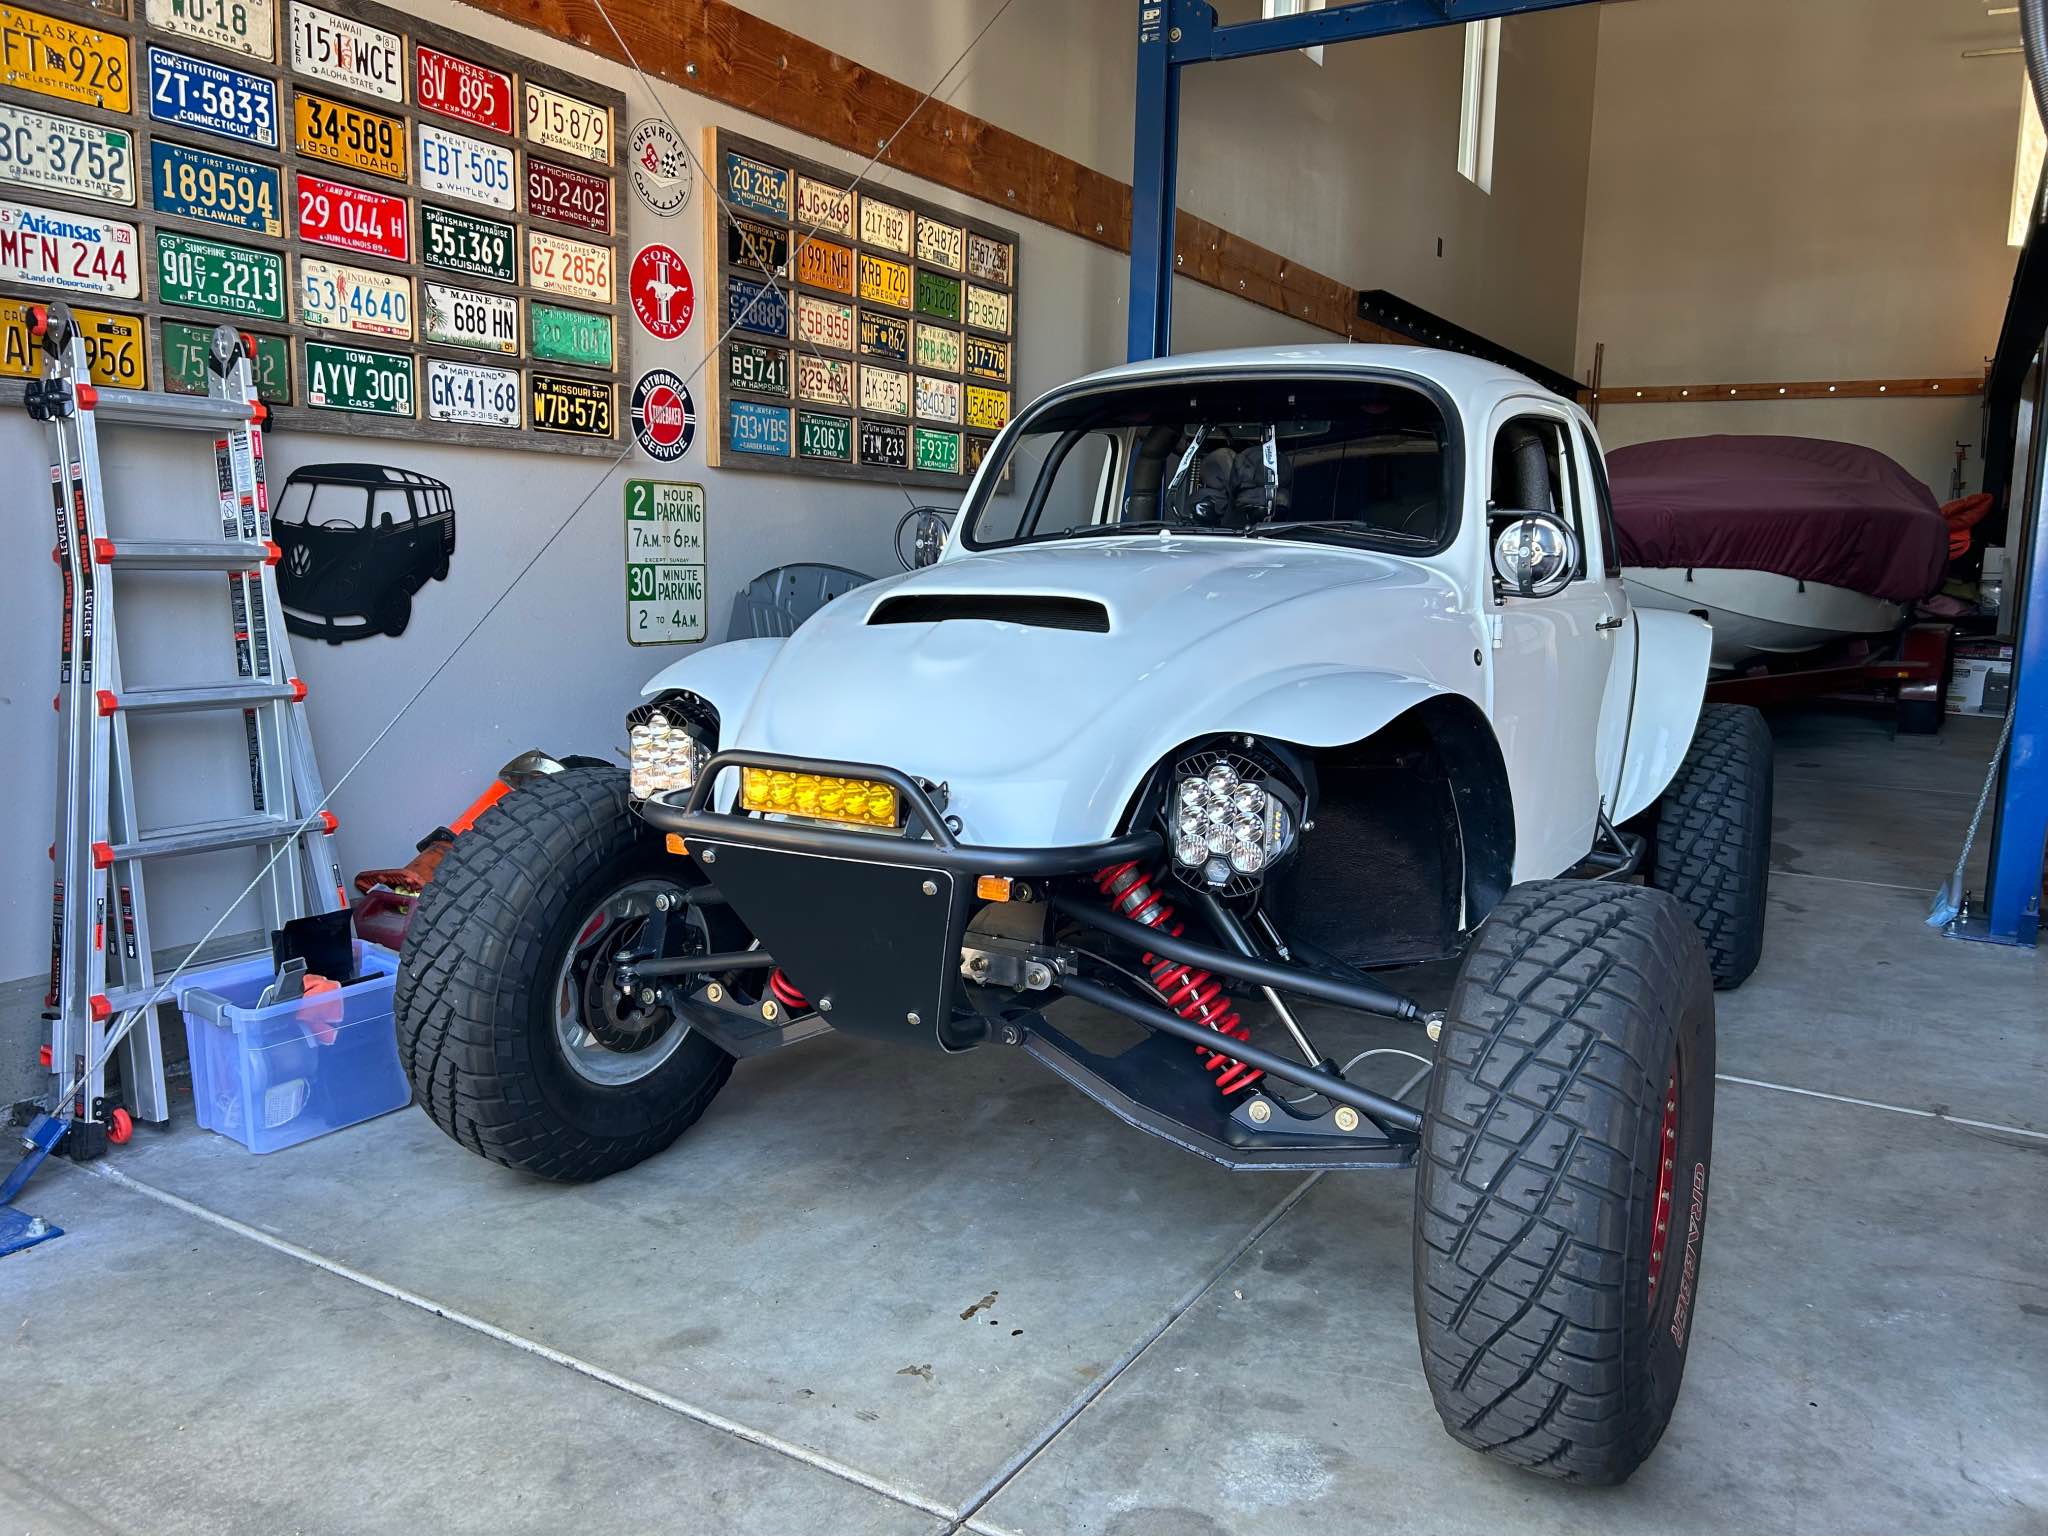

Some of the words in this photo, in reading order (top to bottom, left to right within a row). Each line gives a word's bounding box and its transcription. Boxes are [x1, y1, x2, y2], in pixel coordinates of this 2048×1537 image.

[14, 16, 93, 49] ALASKA
[183, 22, 237, 44] TRACTOR
[329, 18, 363, 37] HAWAII
[305, 23, 342, 68] 151
[354, 38, 397, 84] WCE
[384, 37, 395, 48] 81
[3, 27, 41, 72] FT
[68, 46, 122, 92] 928
[444, 61, 485, 80] KANSAS
[154, 54, 229, 83] CONSTITUTION
[237, 76, 270, 94] STATE
[321, 67, 348, 83] ALOHA
[350, 76, 374, 90] STATE
[33, 75, 57, 87] LAST
[59, 81, 98, 97] FRONTIER
[459, 76, 495, 116] 895
[179, 110, 250, 134] CONNECTICUT
[444, 104, 460, 113] EXP
[461, 108, 476, 120] NOV
[23, 115, 44, 129] C-2
[50, 122, 76, 139] ARIZ
[79, 128, 95, 140] 66
[442, 135, 492, 156] KENTUCKY
[541, 132, 594, 153] MASSACHUSETTS
[633, 126, 688, 169] CHEVROLET
[184, 153, 199, 163] THE
[203, 157, 223, 169] FIRST
[227, 162, 249, 174] STATE
[303, 139, 339, 157] 1930
[355, 153, 399, 173] IDAHO
[9, 165, 41, 178] GRAND
[44, 171, 83, 189] CANYON
[85, 178, 112, 192] STATE
[547, 167, 588, 185] MICHIGAN
[162, 159, 273, 218] 189594
[325, 185, 343, 196] LAND
[344, 189, 352, 198] OF
[446, 183, 490, 198] WHITLEY
[741, 191, 772, 207] MONTANA
[776, 202, 785, 210] 67
[798, 189, 820, 214] AJG
[190, 205, 247, 226] DELAWARE
[300, 192, 330, 228] 29
[339, 201, 383, 239] 044
[391, 216, 402, 239] H
[426, 212, 473, 230] SPORTSMAN'S
[476, 223, 508, 239] PARADISE
[531, 202, 557, 214] WATER
[559, 209, 605, 226] WONDERLAND
[19, 211, 101, 243] Arkansas
[741, 222, 775, 236] NEBRASKA
[160, 238, 175, 249] 69
[184, 242, 227, 258] SUNSHINE
[230, 251, 254, 263] STATE
[264, 257, 277, 267] 70
[325, 234, 341, 244] JUN
[341, 236, 372, 250] ILLINOIS
[571, 245, 591, 256] LAKES
[1, 229, 60, 274] MFN
[73, 242, 127, 285] 244
[163, 250, 192, 287] 90
[426, 253, 438, 263] 66
[443, 257, 494, 275] LOUISIANA
[498, 269, 510, 278] 67
[531, 246, 555, 278] GZ
[562, 253, 606, 287] 2856
[641, 250, 682, 272] FORD
[26, 273, 45, 284] Land
[47, 275, 55, 285] of
[56, 278, 103, 291] Opportunity
[347, 270, 385, 287] INDIANA
[548, 282, 592, 297] MINNESOTA
[887, 267, 905, 293] 720
[187, 291, 257, 311] FLORIDA
[307, 276, 336, 310] 53
[351, 286, 406, 323] 4640
[450, 290, 492, 305] MAINE
[871, 287, 897, 300] OREGON
[454, 302, 486, 335] 688
[492, 309, 514, 340] HN
[636, 297, 690, 335] MUSTANG
[112, 327, 128, 335] 56
[888, 327, 905, 351] 862
[83, 336, 134, 377] 956
[346, 353, 374, 364] IOWA
[731, 344, 739, 352] 19
[176, 343, 204, 377] 75
[732, 355, 784, 386] B9741
[312, 361, 357, 397] AYV
[366, 369, 407, 402] 300
[449, 367, 497, 379] MARYLAND
[552, 384, 591, 397] MISSOURI
[592, 390, 608, 399] SEPT
[640, 373, 687, 401] AUTHORIZED
[732, 379, 746, 387] NEW
[749, 381, 786, 393] HAMPSHIRE
[349, 400, 375, 408] CASS
[651, 404, 682, 426] STUDEBAKER
[641, 434, 687, 457] SERVICE
[886, 438, 904, 457] 233
[74, 489, 84, 529] Little
[633, 485, 646, 517] 2
[663, 490, 693, 501] HOUR
[656, 503, 700, 522] PARKING
[57, 507, 68, 556] LEVELER
[79, 534, 89, 573] Giant
[631, 567, 654, 596] 30
[663, 569, 698, 581] MINUTE
[658, 582, 702, 600] PARKING
[83, 589, 92, 637] LEVELER
[639, 609, 648, 629] 2
[656, 616, 664, 624] TO
[1670, 1162, 1705, 1348] GRABBER
